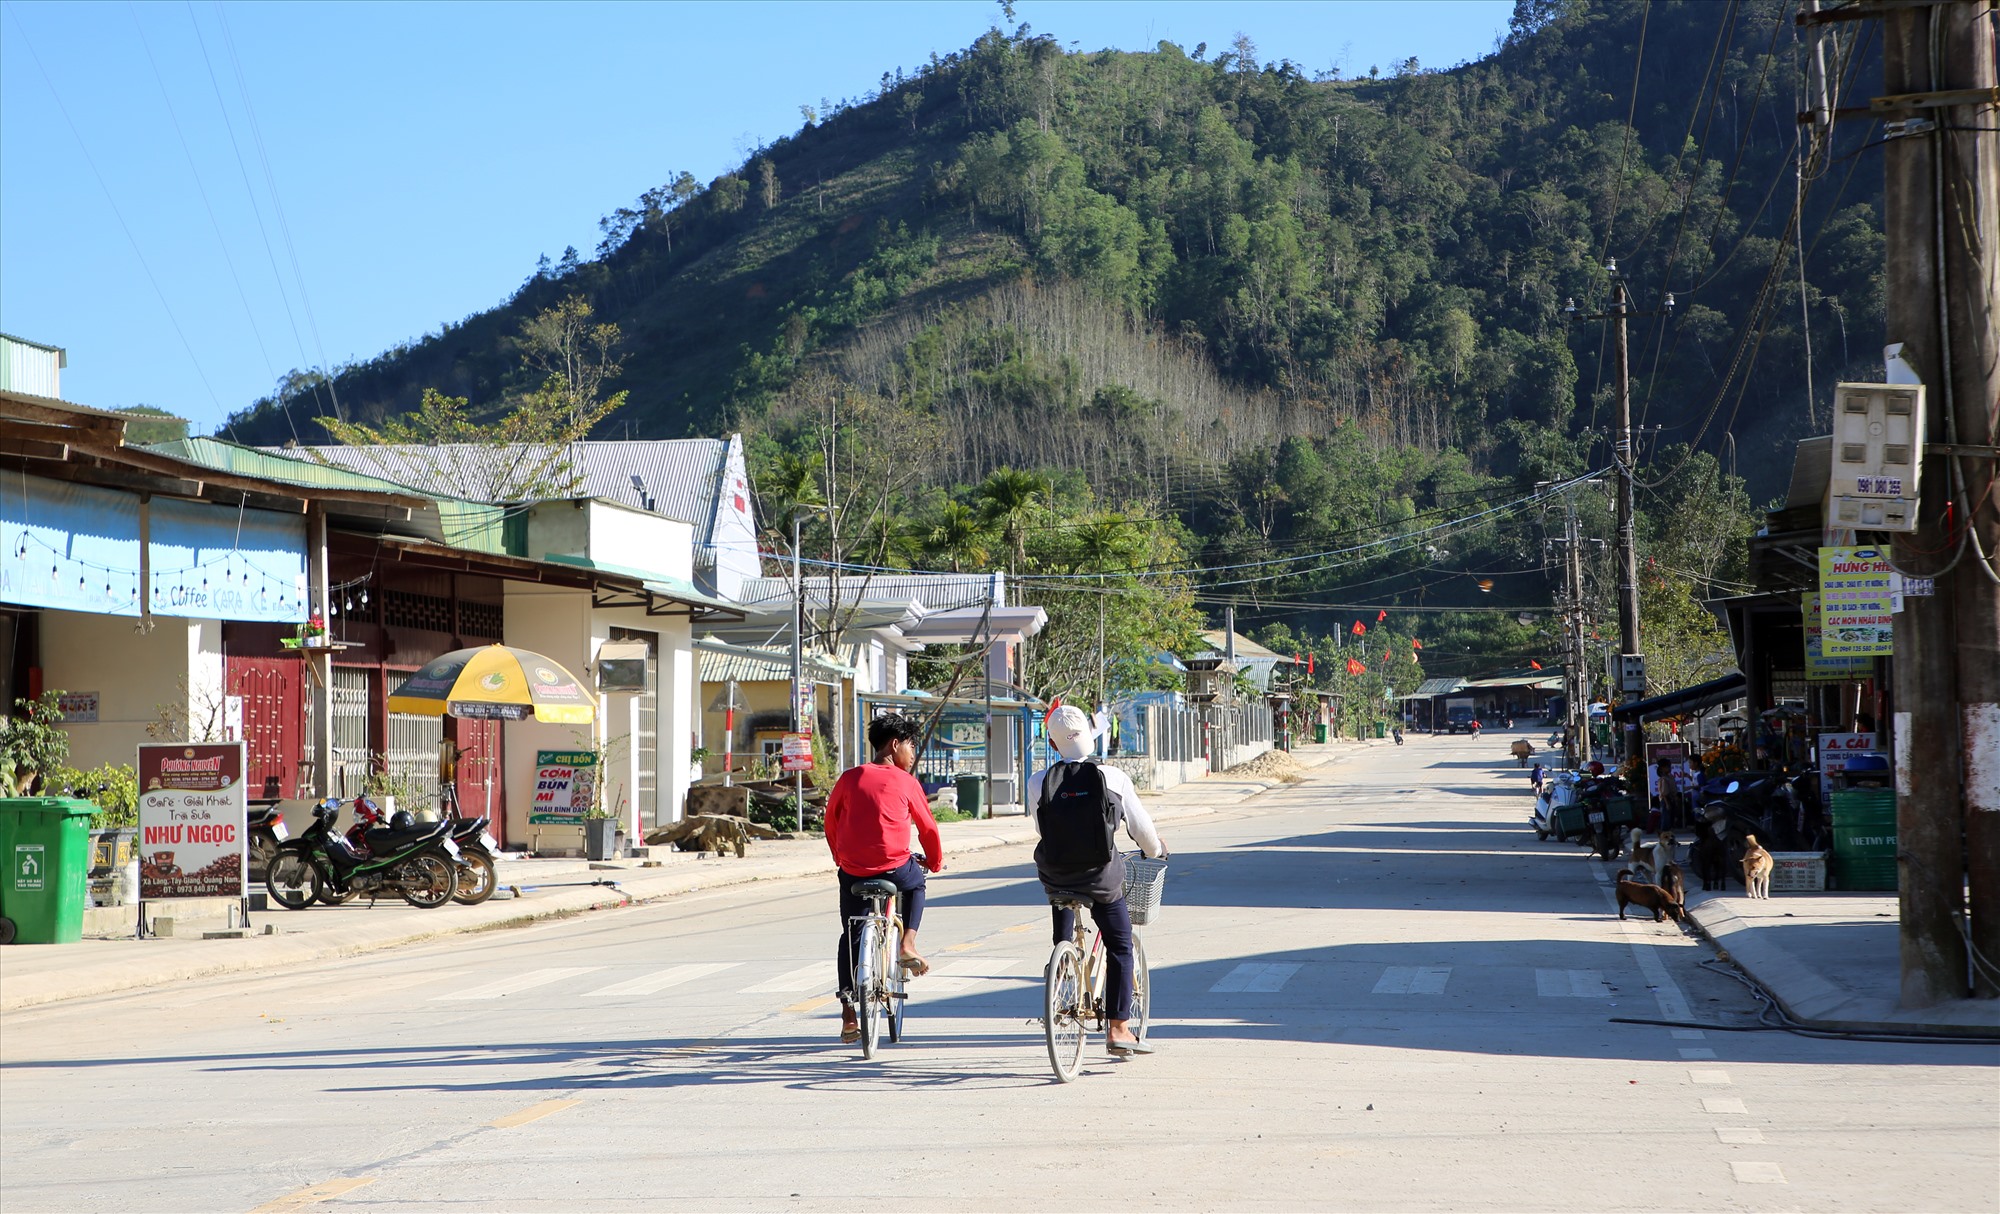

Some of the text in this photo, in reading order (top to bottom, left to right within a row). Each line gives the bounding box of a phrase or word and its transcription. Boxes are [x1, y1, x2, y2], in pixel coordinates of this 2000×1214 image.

[1832, 561, 1870, 573] HƯNG
[170, 585, 208, 608] Coffee
[1827, 735, 1871, 748] A. CẢI
[555, 755, 571, 765] CHỊ
[573, 753, 591, 763] BỐN
[540, 767, 572, 778] CƠM
[537, 779, 568, 789] BÚN
[535, 790, 555, 801] MÌ
[145, 824, 235, 847] NHƯ NGỌC
[1849, 836, 1884, 846] VIETMY
[203, 876, 223, 884] Quảng
